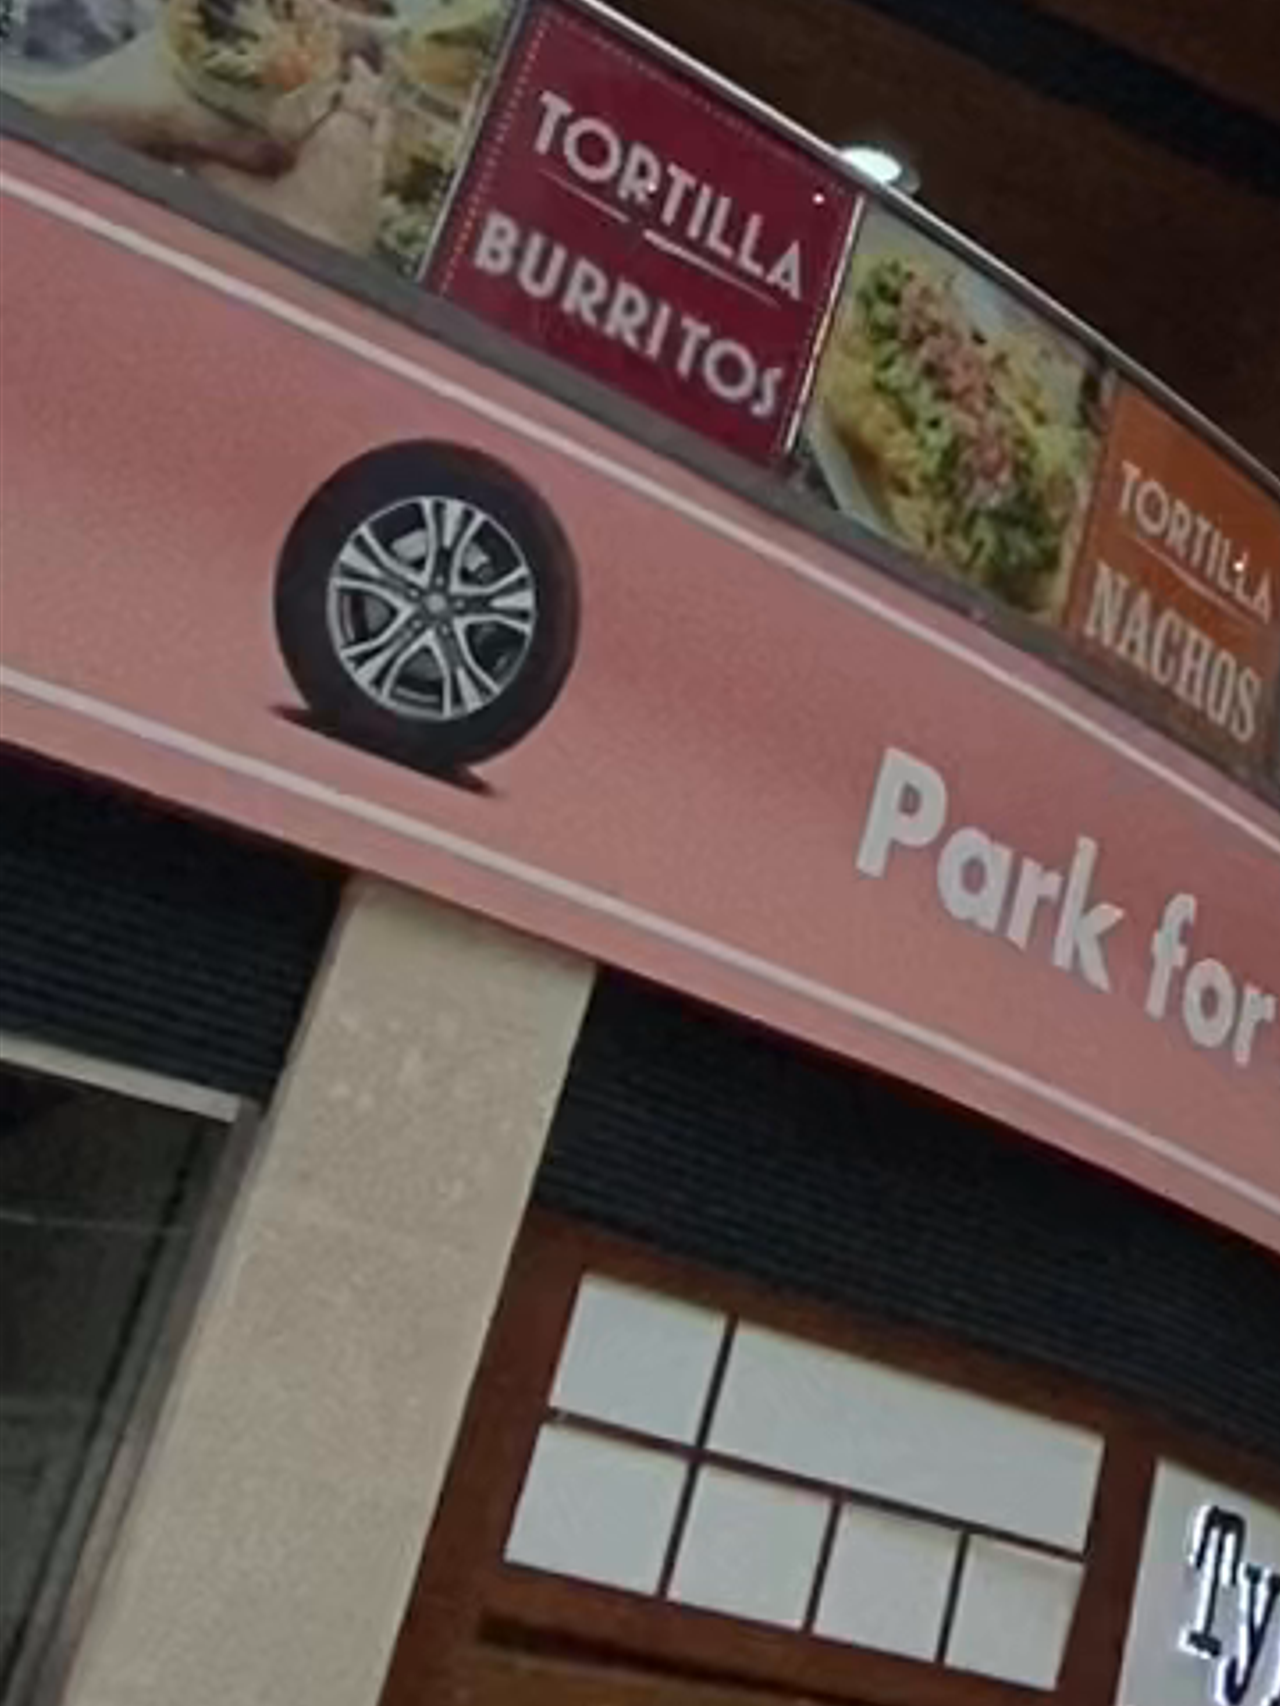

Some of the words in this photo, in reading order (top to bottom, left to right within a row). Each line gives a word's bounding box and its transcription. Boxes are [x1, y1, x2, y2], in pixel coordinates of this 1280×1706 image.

[531, 89, 803, 301] TORTILLA
[473, 209, 786, 418] BURRITOS
[1119, 459, 1274, 625] TORTILLA
[1084, 560, 1264, 744] NACHOS
[854, 746, 1125, 993] Park
[1143, 892, 1277, 1066] for
